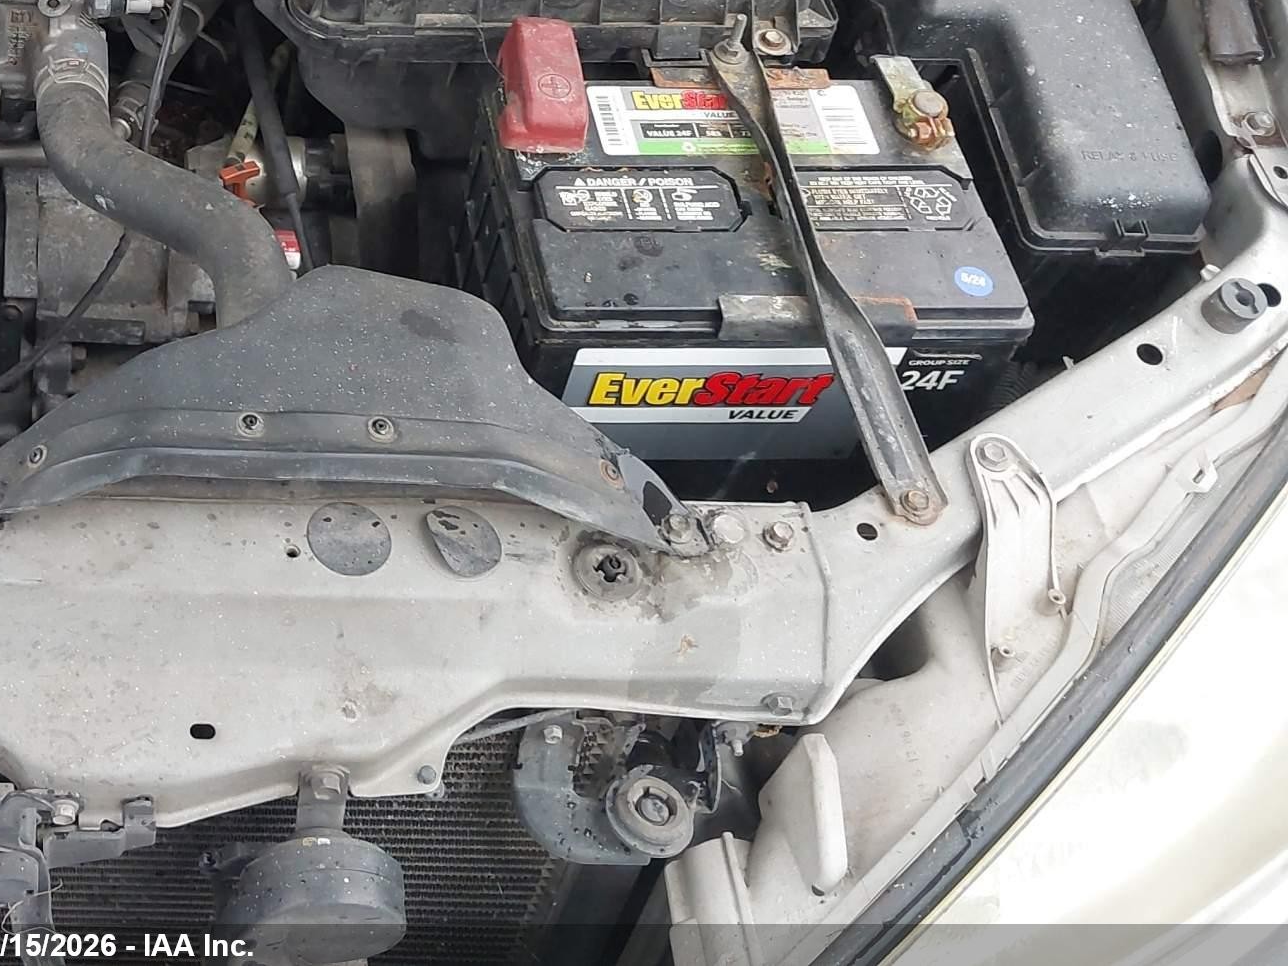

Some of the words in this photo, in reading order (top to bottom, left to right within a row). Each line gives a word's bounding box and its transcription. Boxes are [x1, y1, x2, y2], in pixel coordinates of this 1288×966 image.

[631, 90, 728, 110] EverStar
[586, 177, 637, 186] DANGER
[648, 177, 694, 186] POISON
[588, 370, 835, 407] EverStart
[901, 370, 965, 390] 24F
[728, 409, 799, 420] VALUE
